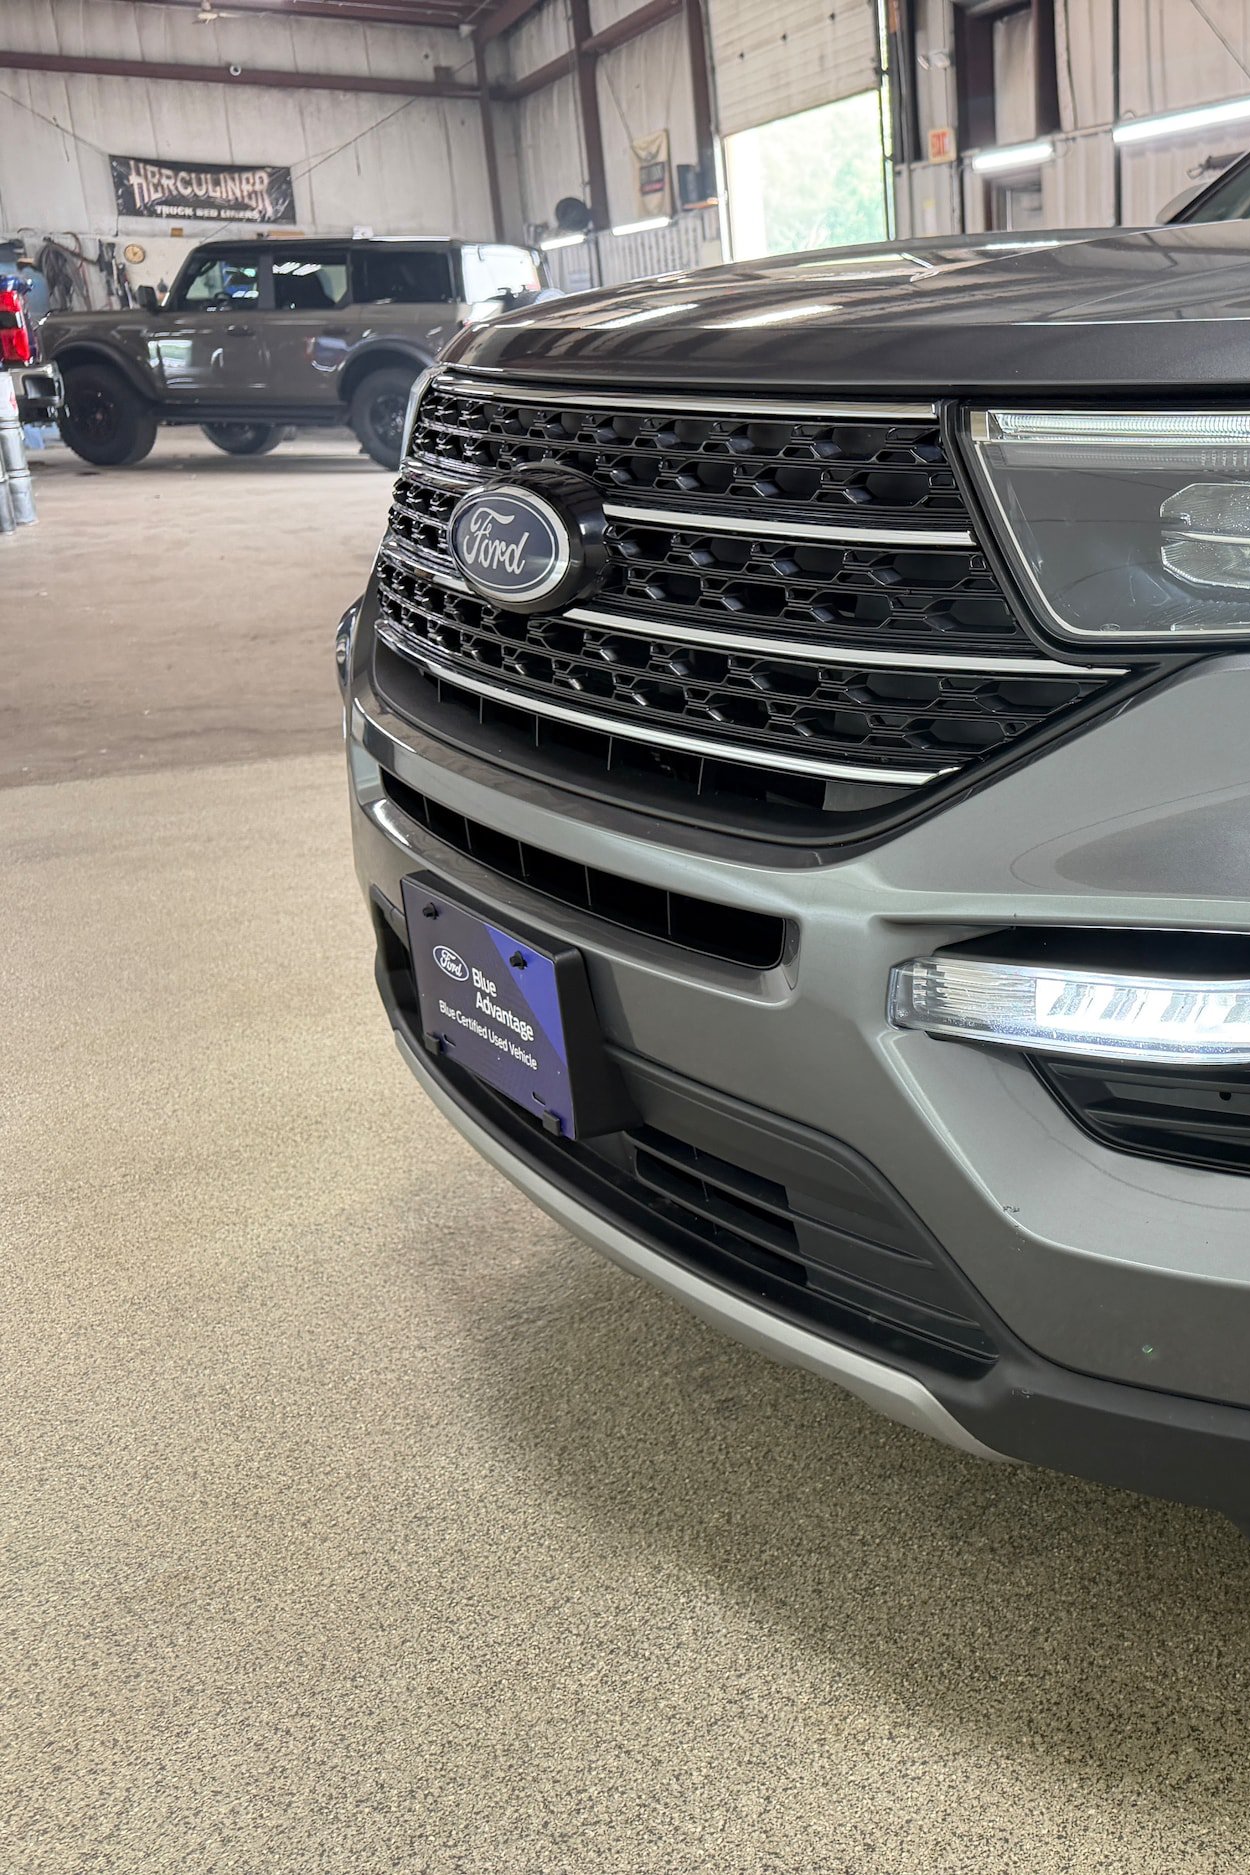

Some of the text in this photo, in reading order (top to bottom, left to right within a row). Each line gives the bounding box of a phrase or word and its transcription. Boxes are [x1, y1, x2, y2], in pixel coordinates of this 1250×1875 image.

[128, 160, 274, 220] HERCULINER
[155, 204, 195, 218] TRUCK
[463, 507, 530, 575] Ford
[440, 949, 463, 977] Ford
[472, 967, 497, 997] Blue
[439, 1000, 538, 1070] Blue Certified Used Vehicle
[476, 991, 535, 1041] Advantage
